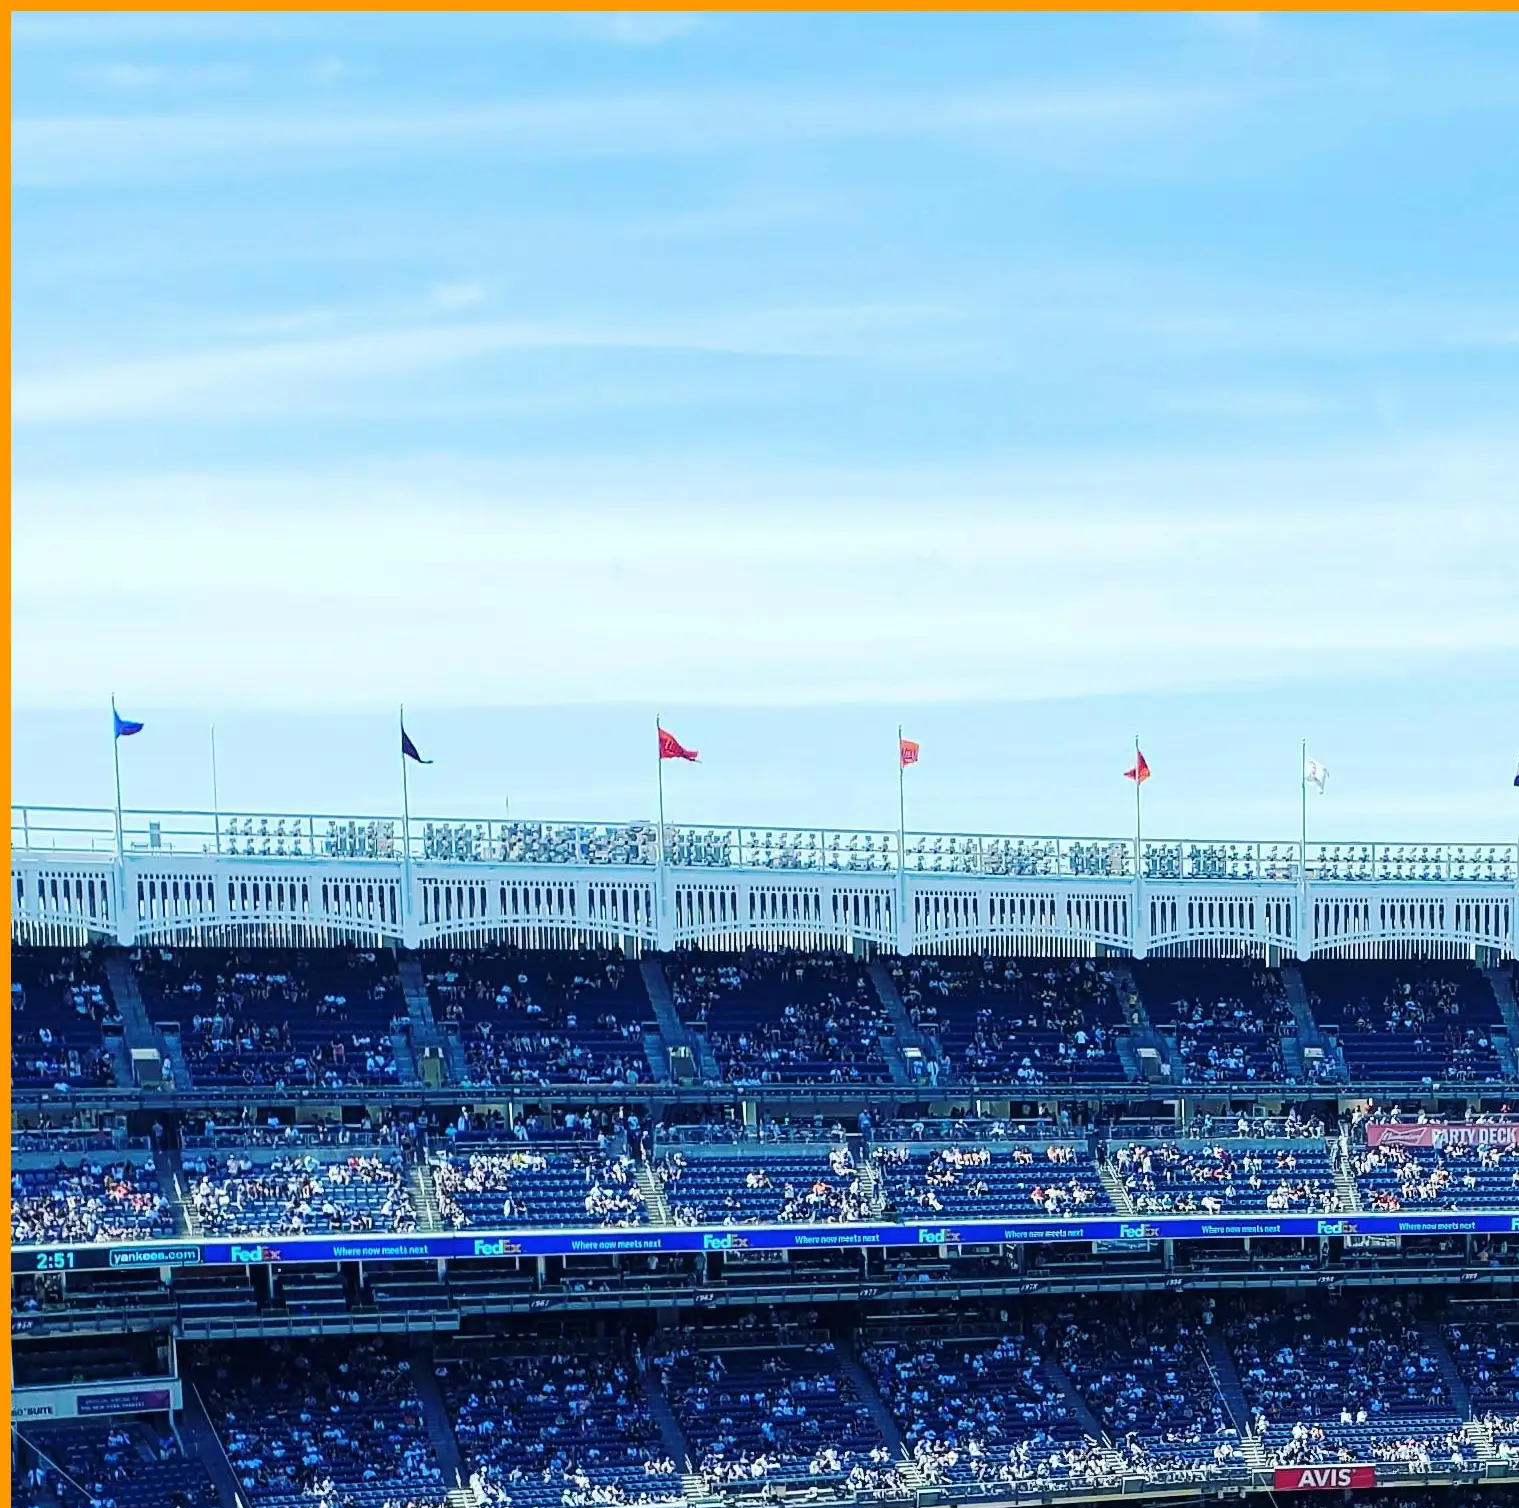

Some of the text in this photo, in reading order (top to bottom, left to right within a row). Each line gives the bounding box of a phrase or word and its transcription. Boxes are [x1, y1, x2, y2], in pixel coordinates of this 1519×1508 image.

[1432, 1128, 1517, 1144] PARTY DECK
[1121, 1224, 1159, 1237] FedEx
[1318, 1221, 1357, 1233] FedEx
[1399, 1222, 1421, 1230] Where
[704, 1234, 748, 1248] FedEx
[795, 1235, 819, 1243] Where
[863, 1234, 879, 1242] next
[919, 1229, 960, 1242] FedEx
[333, 1247, 361, 1256] Where
[382, 1246, 407, 1255] meets
[409, 1245, 428, 1254] next
[475, 1239, 521, 1255] FedEx
[572, 1241, 598, 1249] Where
[618, 1240, 642, 1248] meets
[231, 1245, 281, 1262] FedEx
[36, 1252, 74, 1269] 2:51
[28, 1406, 53, 1415] SUITE
[1298, 1469, 1351, 1487] AVIS
